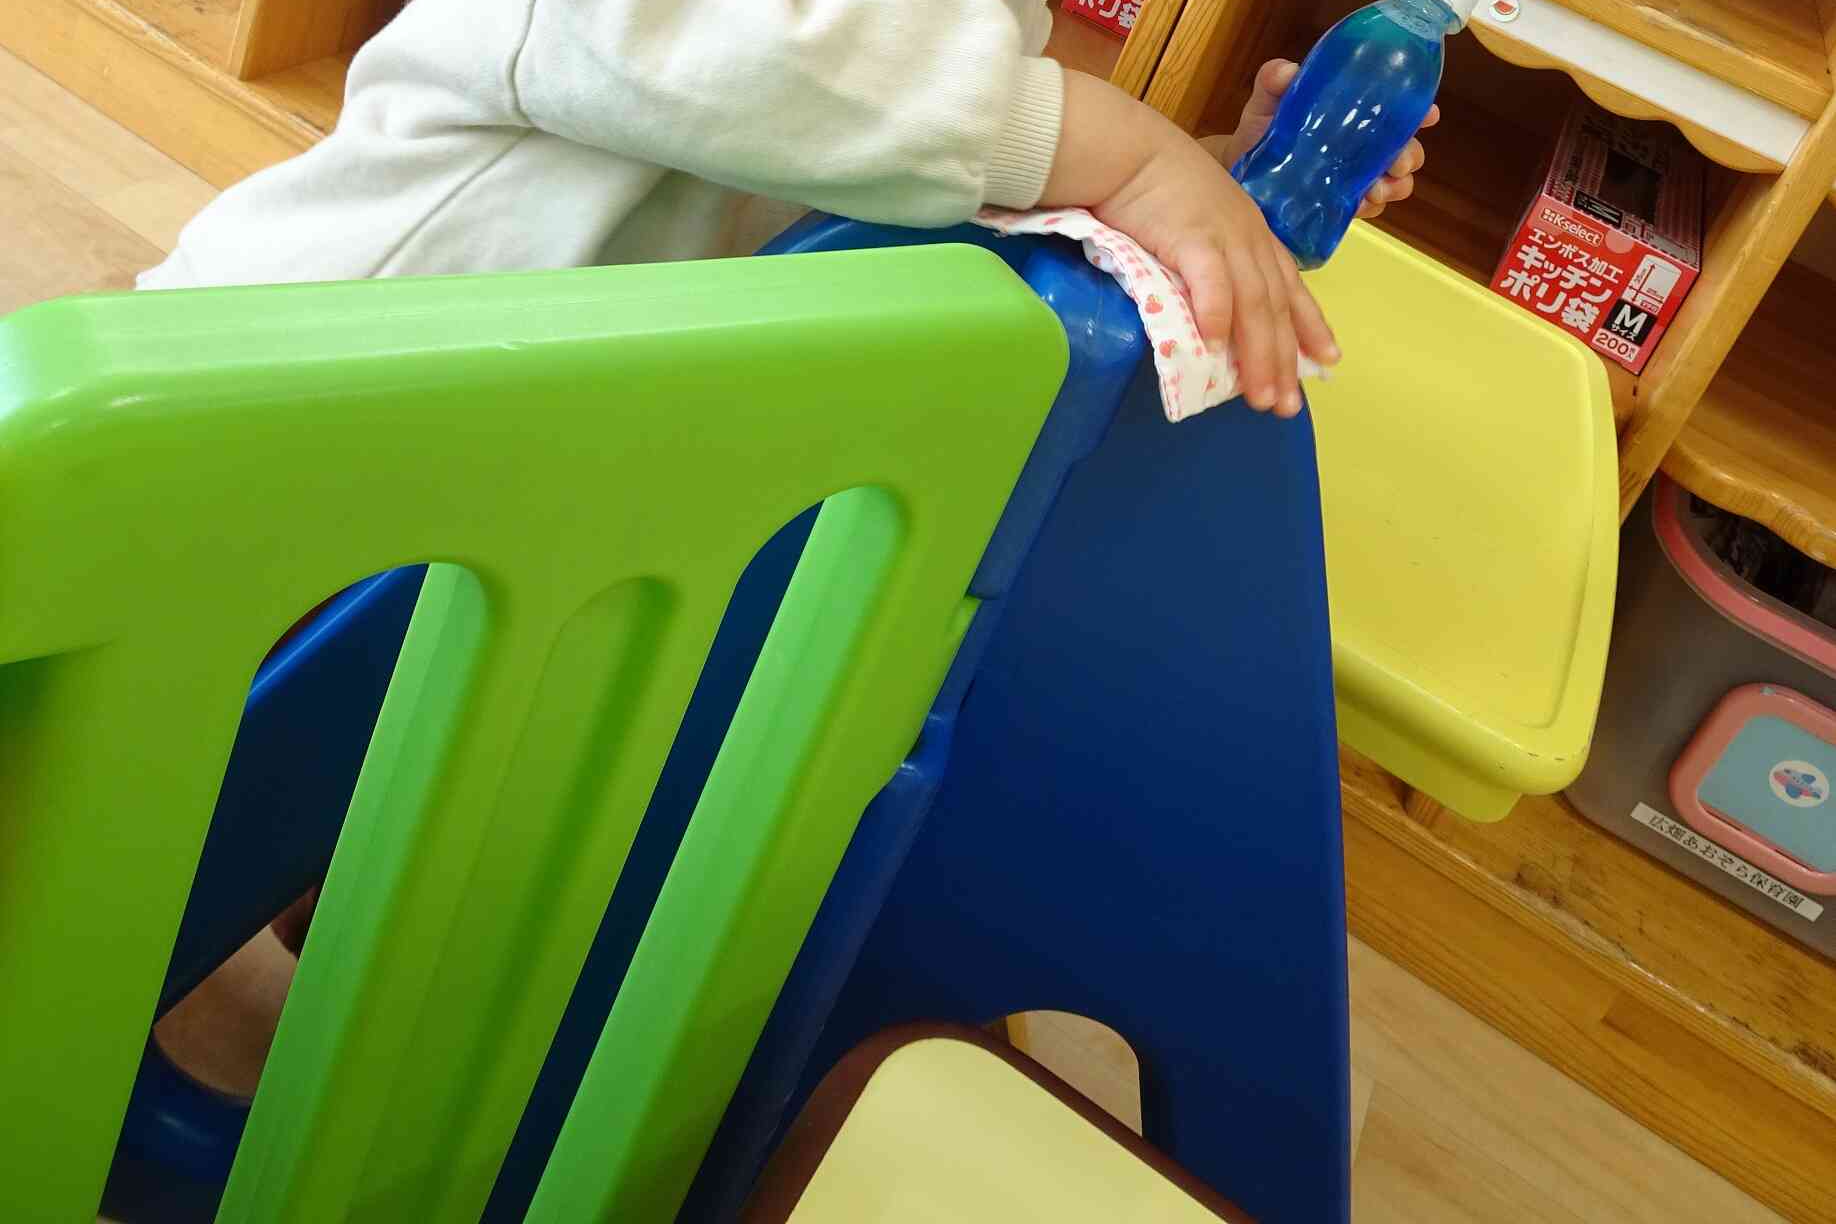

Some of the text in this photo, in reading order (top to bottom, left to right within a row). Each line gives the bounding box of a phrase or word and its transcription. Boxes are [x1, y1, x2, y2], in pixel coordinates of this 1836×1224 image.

[1516, 244, 1613, 304] キッチン
[1528, 228, 1623, 284] エンボス加工
[1500, 268, 1600, 334] ポリ袋
[1614, 304, 1648, 334] M
